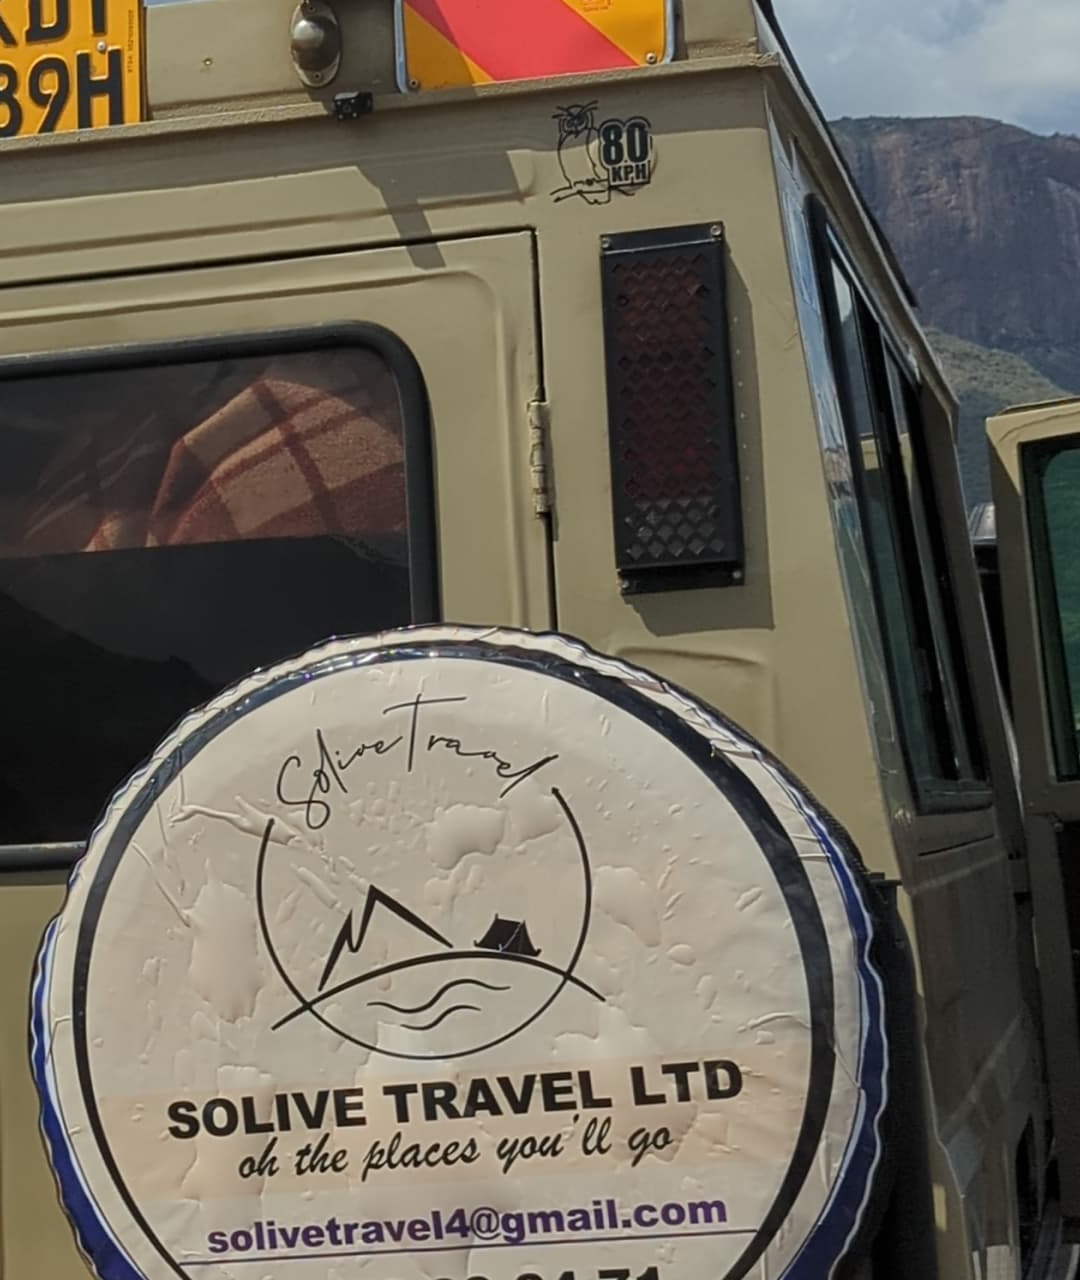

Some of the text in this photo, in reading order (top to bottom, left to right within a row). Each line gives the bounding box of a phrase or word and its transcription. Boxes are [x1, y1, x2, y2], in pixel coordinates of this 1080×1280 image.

[602, 121, 649, 166] 80
[611, 163, 647, 182] KPH
[167, 1059, 743, 1139] SOLIVE TRAVEL LTD
[238, 1113, 673, 1182] oh the places you'll go
[207, 1199, 728, 1253] solivetravel4@gmail.com
